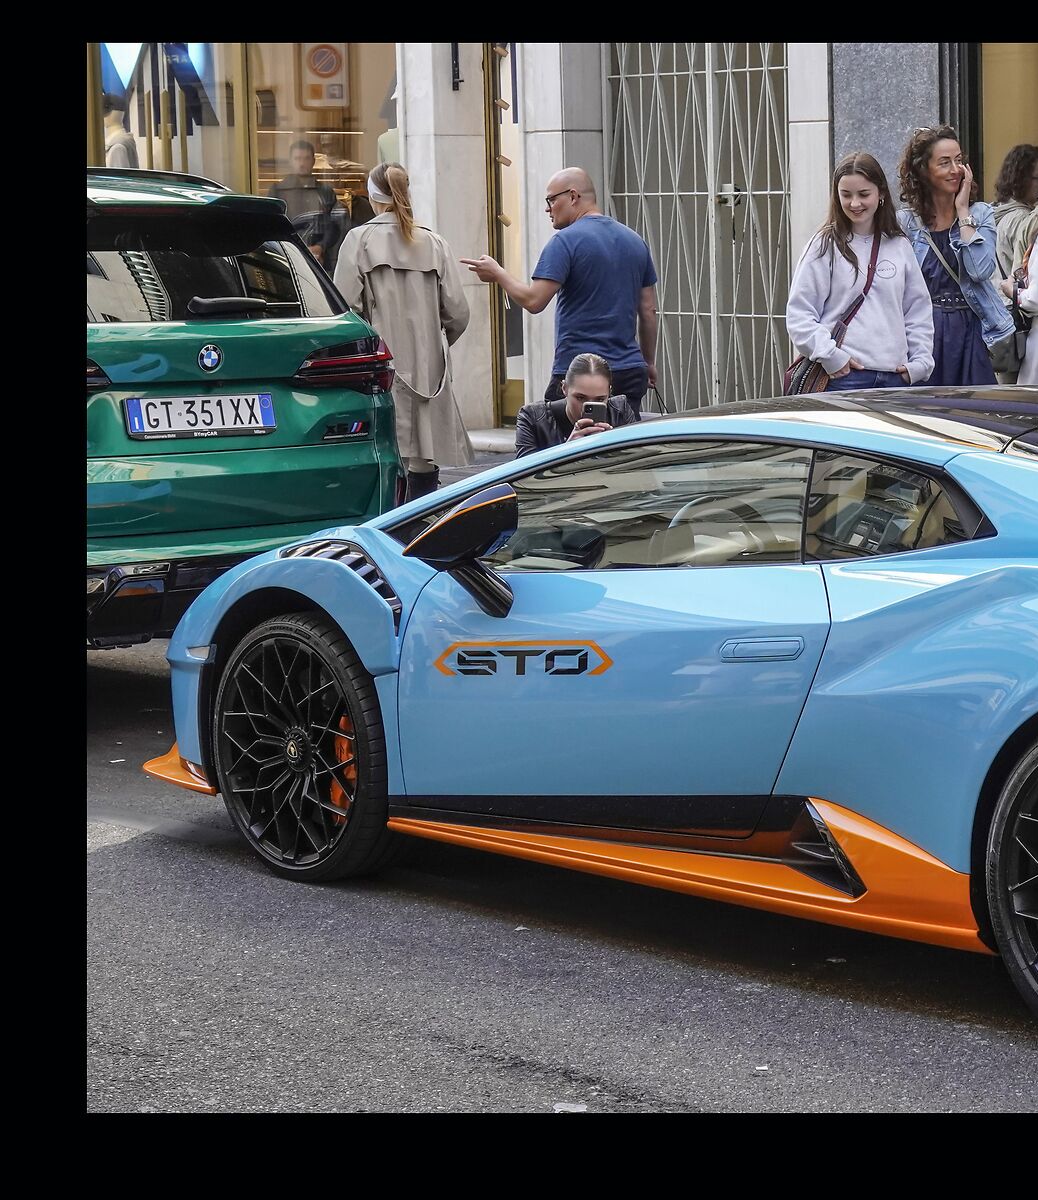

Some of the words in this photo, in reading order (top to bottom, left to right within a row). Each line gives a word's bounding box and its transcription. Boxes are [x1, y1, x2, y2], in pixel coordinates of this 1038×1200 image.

[145, 401, 172, 428] GT
[183, 398, 259, 427] 351XX
[457, 649, 588, 676] STO
